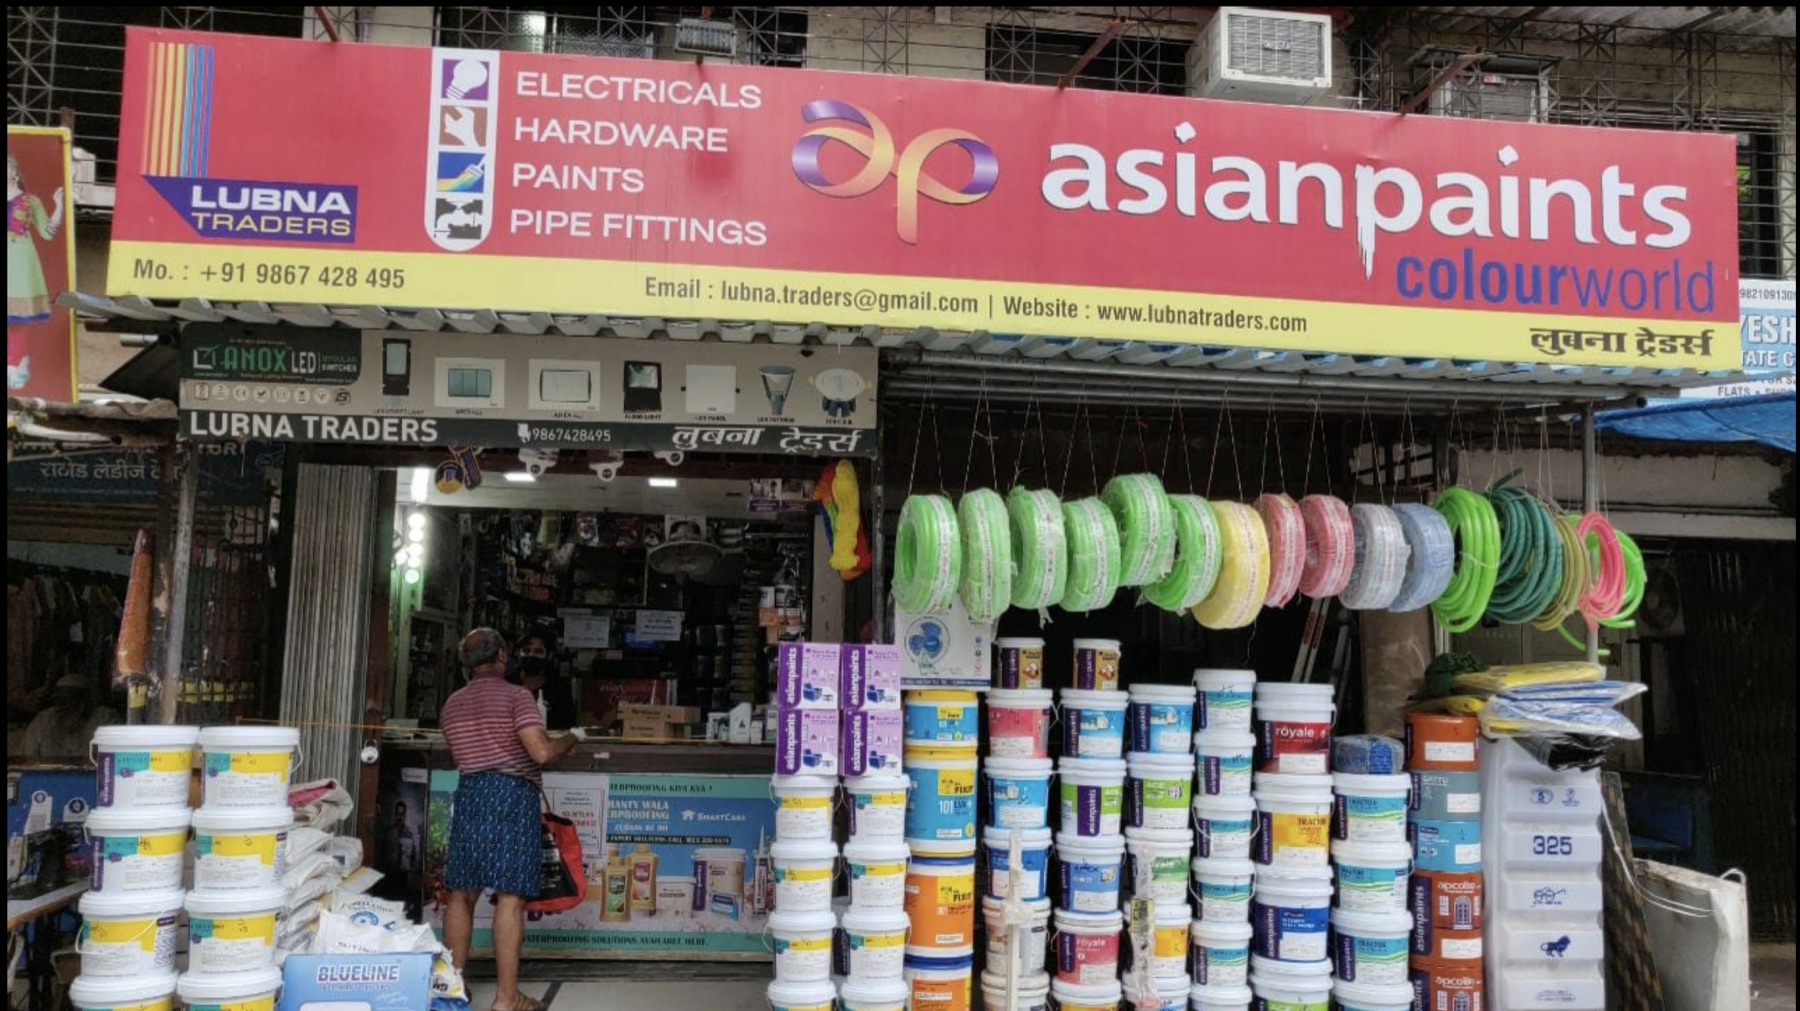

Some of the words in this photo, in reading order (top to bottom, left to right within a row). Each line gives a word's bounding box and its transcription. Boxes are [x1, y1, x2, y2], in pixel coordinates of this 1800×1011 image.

[516, 71, 762, 109] ELECTRICALS
[515, 117, 729, 152] HARDWARE
[512, 163, 645, 193] PAINTS
[191, 184, 351, 215] LUBNA
[1041, 121, 1691, 280] asianpaints
[191, 212, 351, 237] TRADERS
[510, 209, 592, 238] PIPE
[602, 212, 768, 247] FITTINGS
[133, 259, 175, 281] Mo.
[201, 263, 245, 284] +91
[255, 262, 310, 286] 9867
[318, 265, 358, 288] 428
[365, 267, 405, 290] 495
[1395, 248, 1715, 313] colourworld
[644, 276, 701, 300] Email
[721, 280, 979, 315] lubna.traders@gmail.com
[1003, 295, 1078, 320] Website
[1097, 303, 1308, 333] www.lubnatraders.com
[1530, 327, 1626, 356] लुबना
[1636, 328, 1715, 357] ट्रेडर्स
[291, 351, 317, 374] LED
[1783, 351, 1796, 367] C
[1718, 386, 1751, 397] FLATS
[190, 411, 295, 439] LUBNA
[302, 414, 439, 443] TRADERS
[532, 428, 611, 442] 9867428495
[671, 426, 765, 449] लुबना
[780, 427, 863, 453] ट्रेडर्स
[94, 459, 144, 480] लेडीज
[786, 647, 797, 704] asianpaints
[850, 649, 862, 706] asianpaints
[786, 712, 797, 770] asianpaints
[852, 714, 864, 771] asianpaints
[939, 800, 954, 814] 101
[1087, 788, 1098, 834] asianpaints
[1533, 835, 1572, 855] 325
[1415, 885, 1428, 951] asianpaints
[591, 936, 638, 945] SOLUTIONS
[316, 964, 400, 983] BLUELINE
